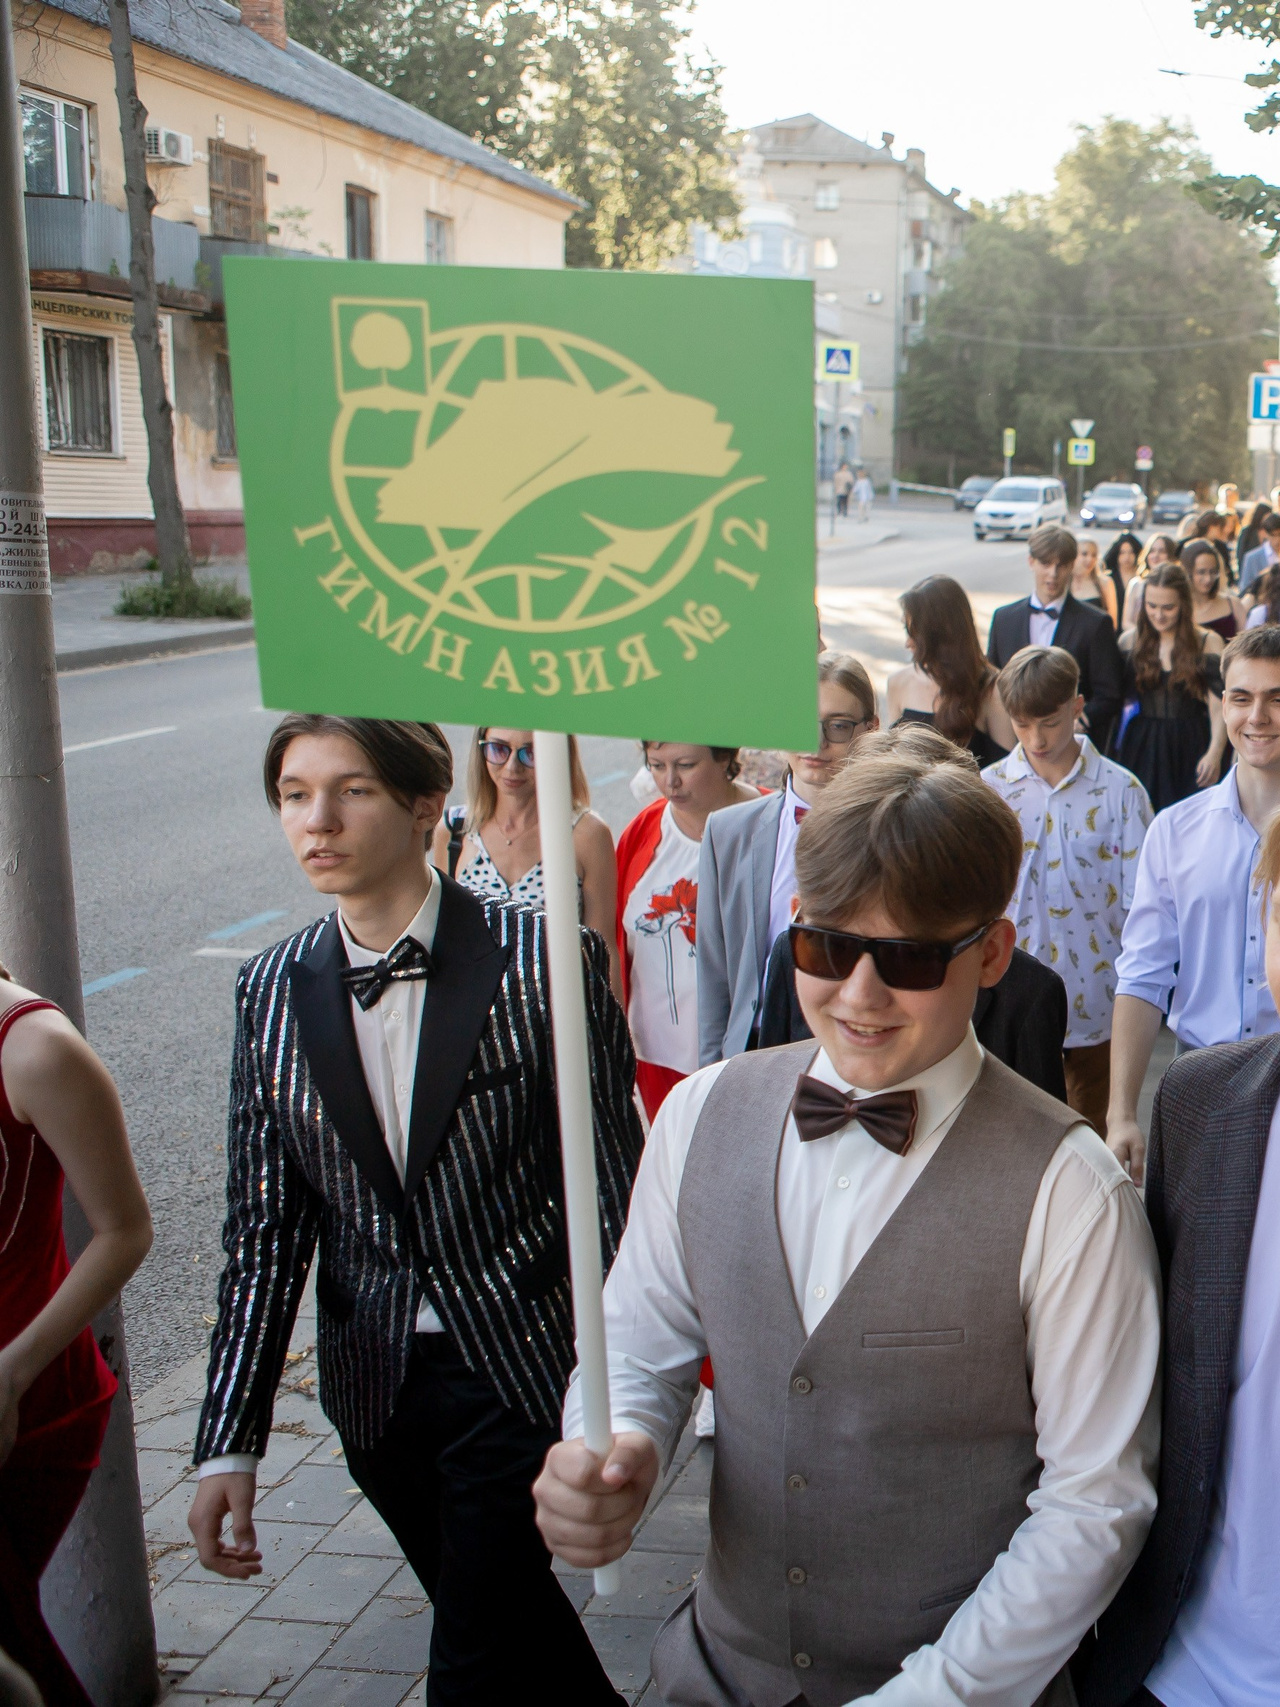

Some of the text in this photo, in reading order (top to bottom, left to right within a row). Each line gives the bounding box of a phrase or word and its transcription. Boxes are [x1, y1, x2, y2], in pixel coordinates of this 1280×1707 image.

[293, 514, 769, 697] ГИМНАЗИЯ № 12
